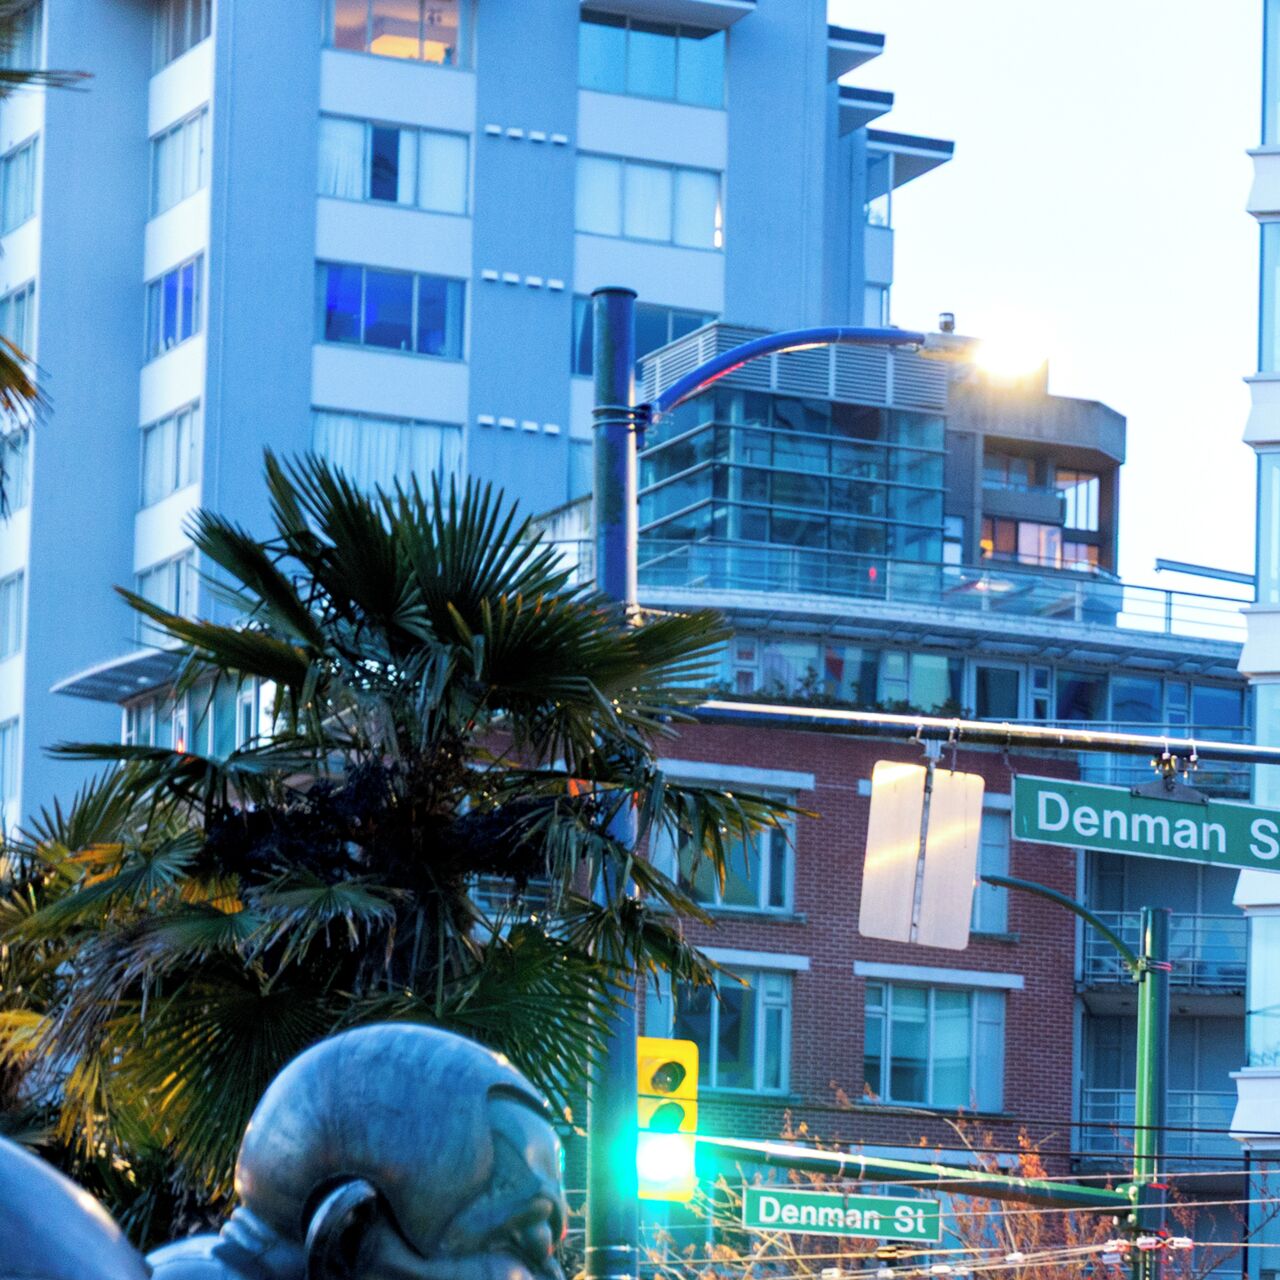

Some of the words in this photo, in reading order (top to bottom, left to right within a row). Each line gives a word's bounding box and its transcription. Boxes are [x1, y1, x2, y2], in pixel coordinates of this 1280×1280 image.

[1037, 790, 1227, 853] Denman
[758, 1196, 880, 1231] Denman
[893, 1205, 926, 1234] St
